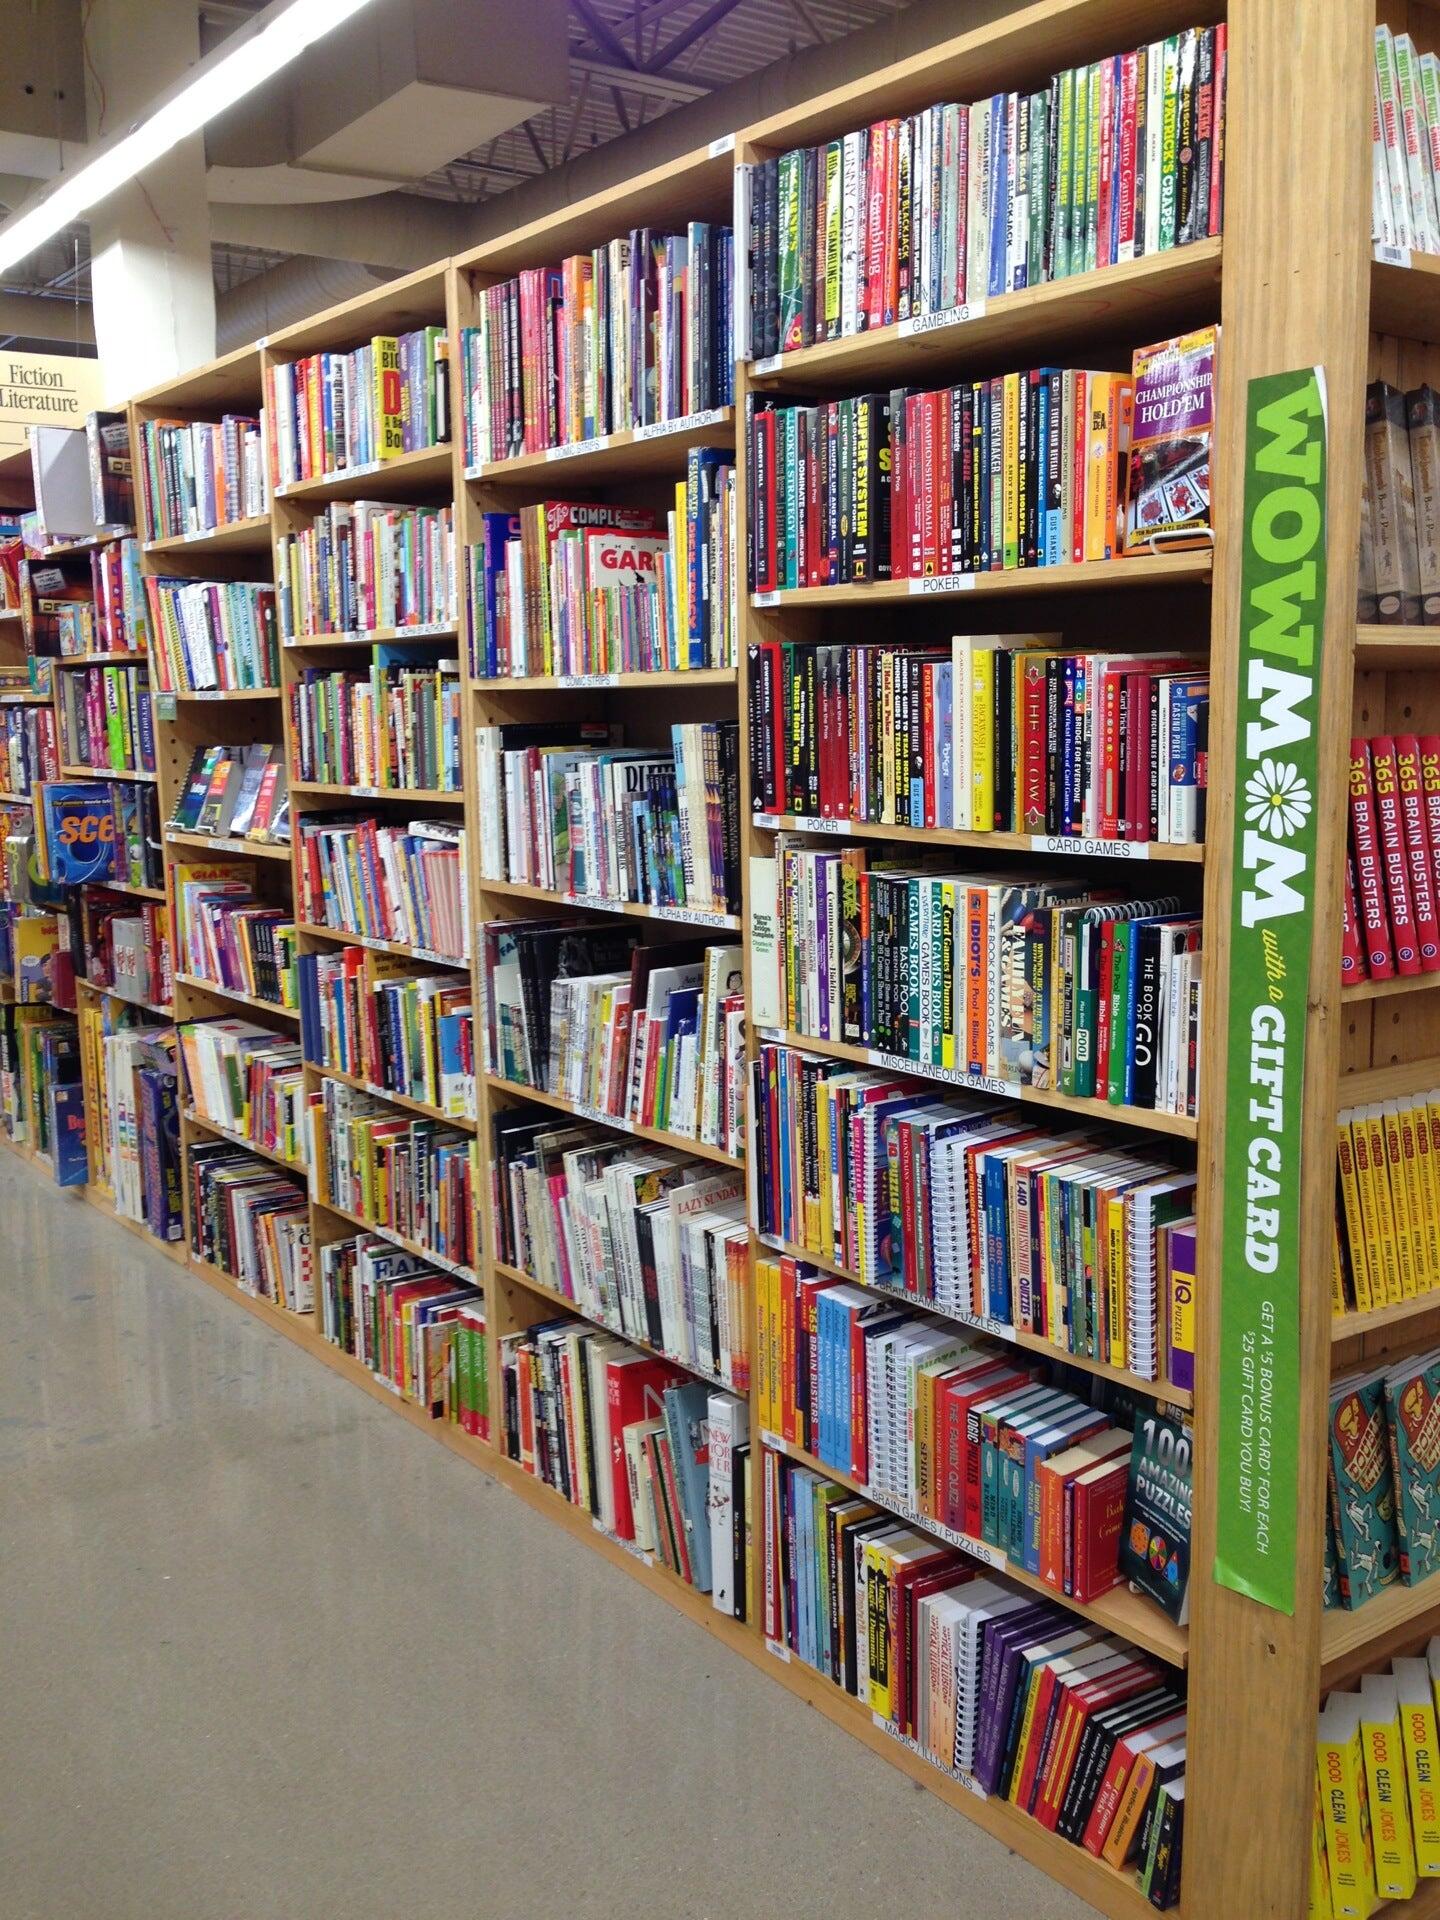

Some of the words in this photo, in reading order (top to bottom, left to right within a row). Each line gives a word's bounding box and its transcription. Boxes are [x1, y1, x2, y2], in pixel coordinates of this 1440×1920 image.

[1376, 39, 1389, 71] PHOTO
[1380, 70, 1393, 101] PUZZLE
[1121, 119, 1133, 165] Casino
[1162, 99, 1173, 173] PATRICK'S
[1384, 100, 1398, 150] CHALLENGE
[1119, 170, 1132, 239] Gambling
[1160, 175, 1172, 226] CRAPS
[869, 192, 883, 276] Gambling
[912, 306, 970, 332] GAMBLING
[9, 364, 64, 387] Fiction
[1135, 371, 1213, 406] CHAMPIONSHIP
[0, 388, 79, 413] Literature
[1050, 408, 1058, 428] EVERY
[1141, 391, 1206, 425] HOLD'EM
[643, 423, 667, 438] ALPHA
[668, 421, 679, 432] BY
[680, 413, 711, 430] AUTHOR
[857, 403, 869, 465] SUPER
[991, 403, 1001, 473] MONEYMAKER
[1050, 430, 1058, 447] HAND
[924, 404, 933, 493] CHAMPIONSHIP
[1020, 449, 1026, 460] TO
[1050, 449, 1058, 479] REVEALED
[570, 506, 622, 526] COMPLE
[857, 467, 868, 537] SYSTEM
[1249, 376, 1322, 666] WOW
[600, 548, 655, 571] GAR
[923, 577, 960, 592] POKER
[565, 677, 586, 687] COMIC
[587, 676, 611, 686] STRIPS
[1064, 680, 1073, 704] BICYCLE
[793, 714, 801, 738] Hold
[1172, 703, 1181, 731] CASINO
[793, 742, 801, 765] 'em
[1151, 761, 1157, 769] OF
[1172, 735, 1181, 759] POKER
[1073, 764, 1081, 803] EVERYONE
[1349, 757, 1368, 796] 365
[1374, 755, 1394, 794] 365
[1397, 753, 1418, 792] 365
[807, 819, 838, 832] POKER
[1354, 802, 1371, 851] BRAIN
[1381, 799, 1399, 848] BRAIN
[1404, 797, 1422, 845] BRAIN
[1047, 838, 1081, 853] CARD
[1084, 841, 1130, 857] GAMES
[1360, 856, 1380, 929] BUSTERS
[1388, 853, 1408, 925] BUSTERS
[1411, 851, 1431, 922] BUSTERS
[658, 907, 680, 919] ALPHA
[681, 911, 692, 921] BY
[693, 912, 725, 926] AUTHOR
[909, 896, 918, 950] GAMES
[932, 901, 941, 938] CARD
[899, 946, 908, 981] BASIC
[932, 941, 941, 987] GAMES
[971, 920, 981, 977] IDIOT'S
[1011, 925, 1025, 1002] FAMILY
[1261, 928, 1287, 980] with
[909, 954, 918, 996] BOOK
[1144, 957, 1154, 980] THE
[900, 984, 908, 1017] POOL
[932, 990, 941, 1027] BOOK
[943, 981, 951, 1029] Dummies
[1144, 985, 1153, 1021] BOOK
[1011, 1005, 1025, 1041] FUN
[1135, 1023, 1152, 1067] GO
[881, 1055, 965, 1084] MISCELLANEOUS
[967, 1071, 1006, 1093] GAMES
[1250, 1005, 1286, 1133] GIFT
[581, 1107, 603, 1120] COMIC
[603, 1114, 625, 1129] STRIPS
[677, 1197, 702, 1215] LAZY
[703, 1189, 738, 1207] SUNDAY
[1245, 1137, 1282, 1274] CARD
[880, 1281, 908, 1298] BRAIN
[910, 1292, 946, 1314] GAMES
[954, 1309, 1001, 1334] PUZZLES
[1020, 1278, 1030, 1315] QUIZZES
[1175, 1279, 1191, 1303] IQ
[1174, 1305, 1182, 1342] PUZZLES
[1261, 1301, 1274, 1333] GET
[1242, 1331, 1256, 1352] $25
[1261, 1335, 1273, 1345] A
[1242, 1357, 1254, 1392] GIFT
[1259, 1368, 1273, 1423] BONUS
[967, 1414, 978, 1443] LOGIC
[1240, 1394, 1253, 1437] CARD
[920, 1441, 929, 1499] SPHINX
[1240, 1441, 1252, 1473] YOU
[1136, 1474, 1193, 1530] PUZZLES
[1239, 1476, 1252, 1512] BUY!
[1257, 1477, 1270, 1508] FOR
[872, 1490, 901, 1514] BRAIN
[902, 1507, 938, 1533] GAMES
[945, 1528, 991, 1562] PUZZLES
[1256, 1511, 1269, 1554] EACH
[878, 1583, 886, 1613] Magic
[878, 1626, 886, 1672] Dummies
[1411, 1713, 1426, 1744] GOOD
[884, 1720, 915, 1751] MAGIC
[920, 1750, 973, 1790] ILLUSIONS
[1372, 1731, 1387, 1763] GOOD
[1327, 1752, 1342, 1783] GOOD
[1415, 1749, 1431, 1783] CLEAN
[1376, 1768, 1392, 1803] CLEAN
[1331, 1788, 1347, 1824] CLEAN
[1419, 1788, 1436, 1822] JOKES
[1379, 1807, 1396, 1842] JOKES
[1334, 1829, 1351, 1864] JOKES
